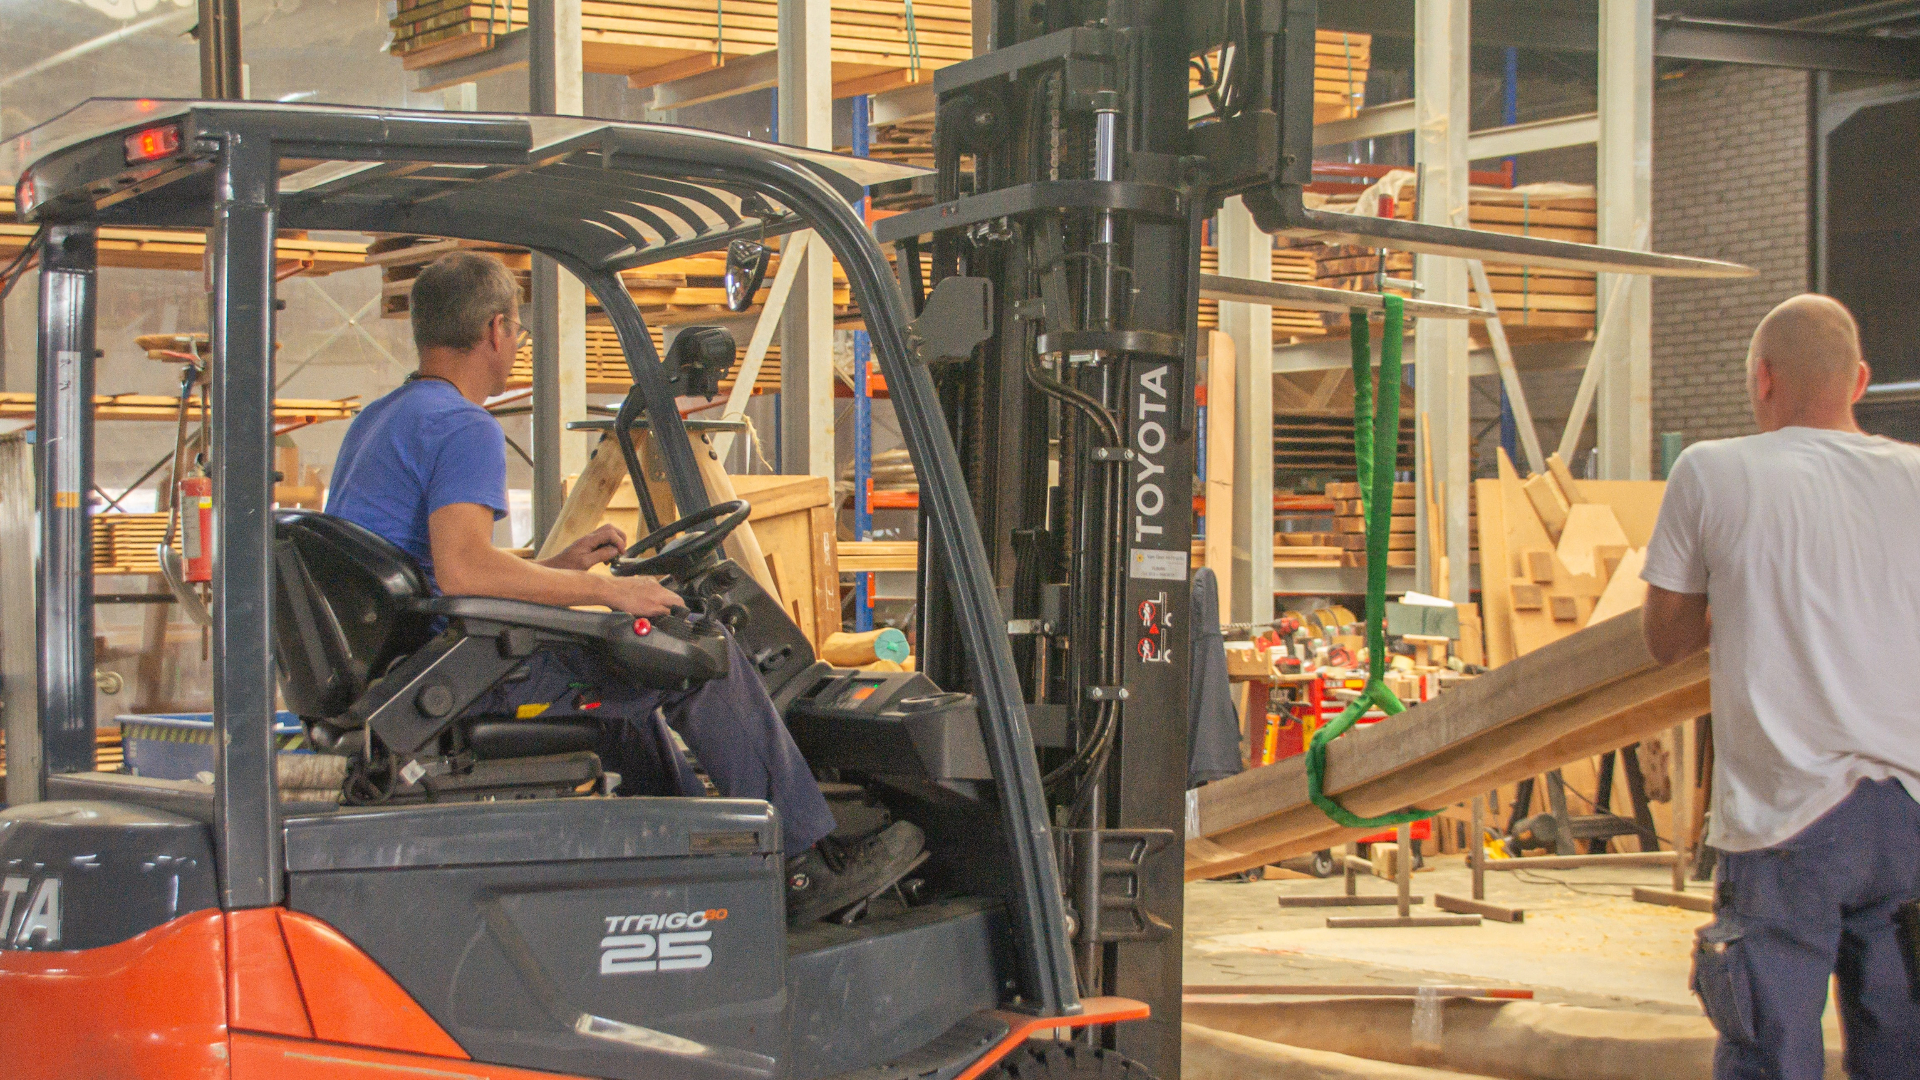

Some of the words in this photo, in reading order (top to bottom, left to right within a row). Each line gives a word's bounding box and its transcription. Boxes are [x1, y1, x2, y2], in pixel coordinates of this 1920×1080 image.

[1135, 365, 1168, 543] TOYOTA
[605, 911, 708, 933] TRAIGO
[601, 930, 713, 975] 25
